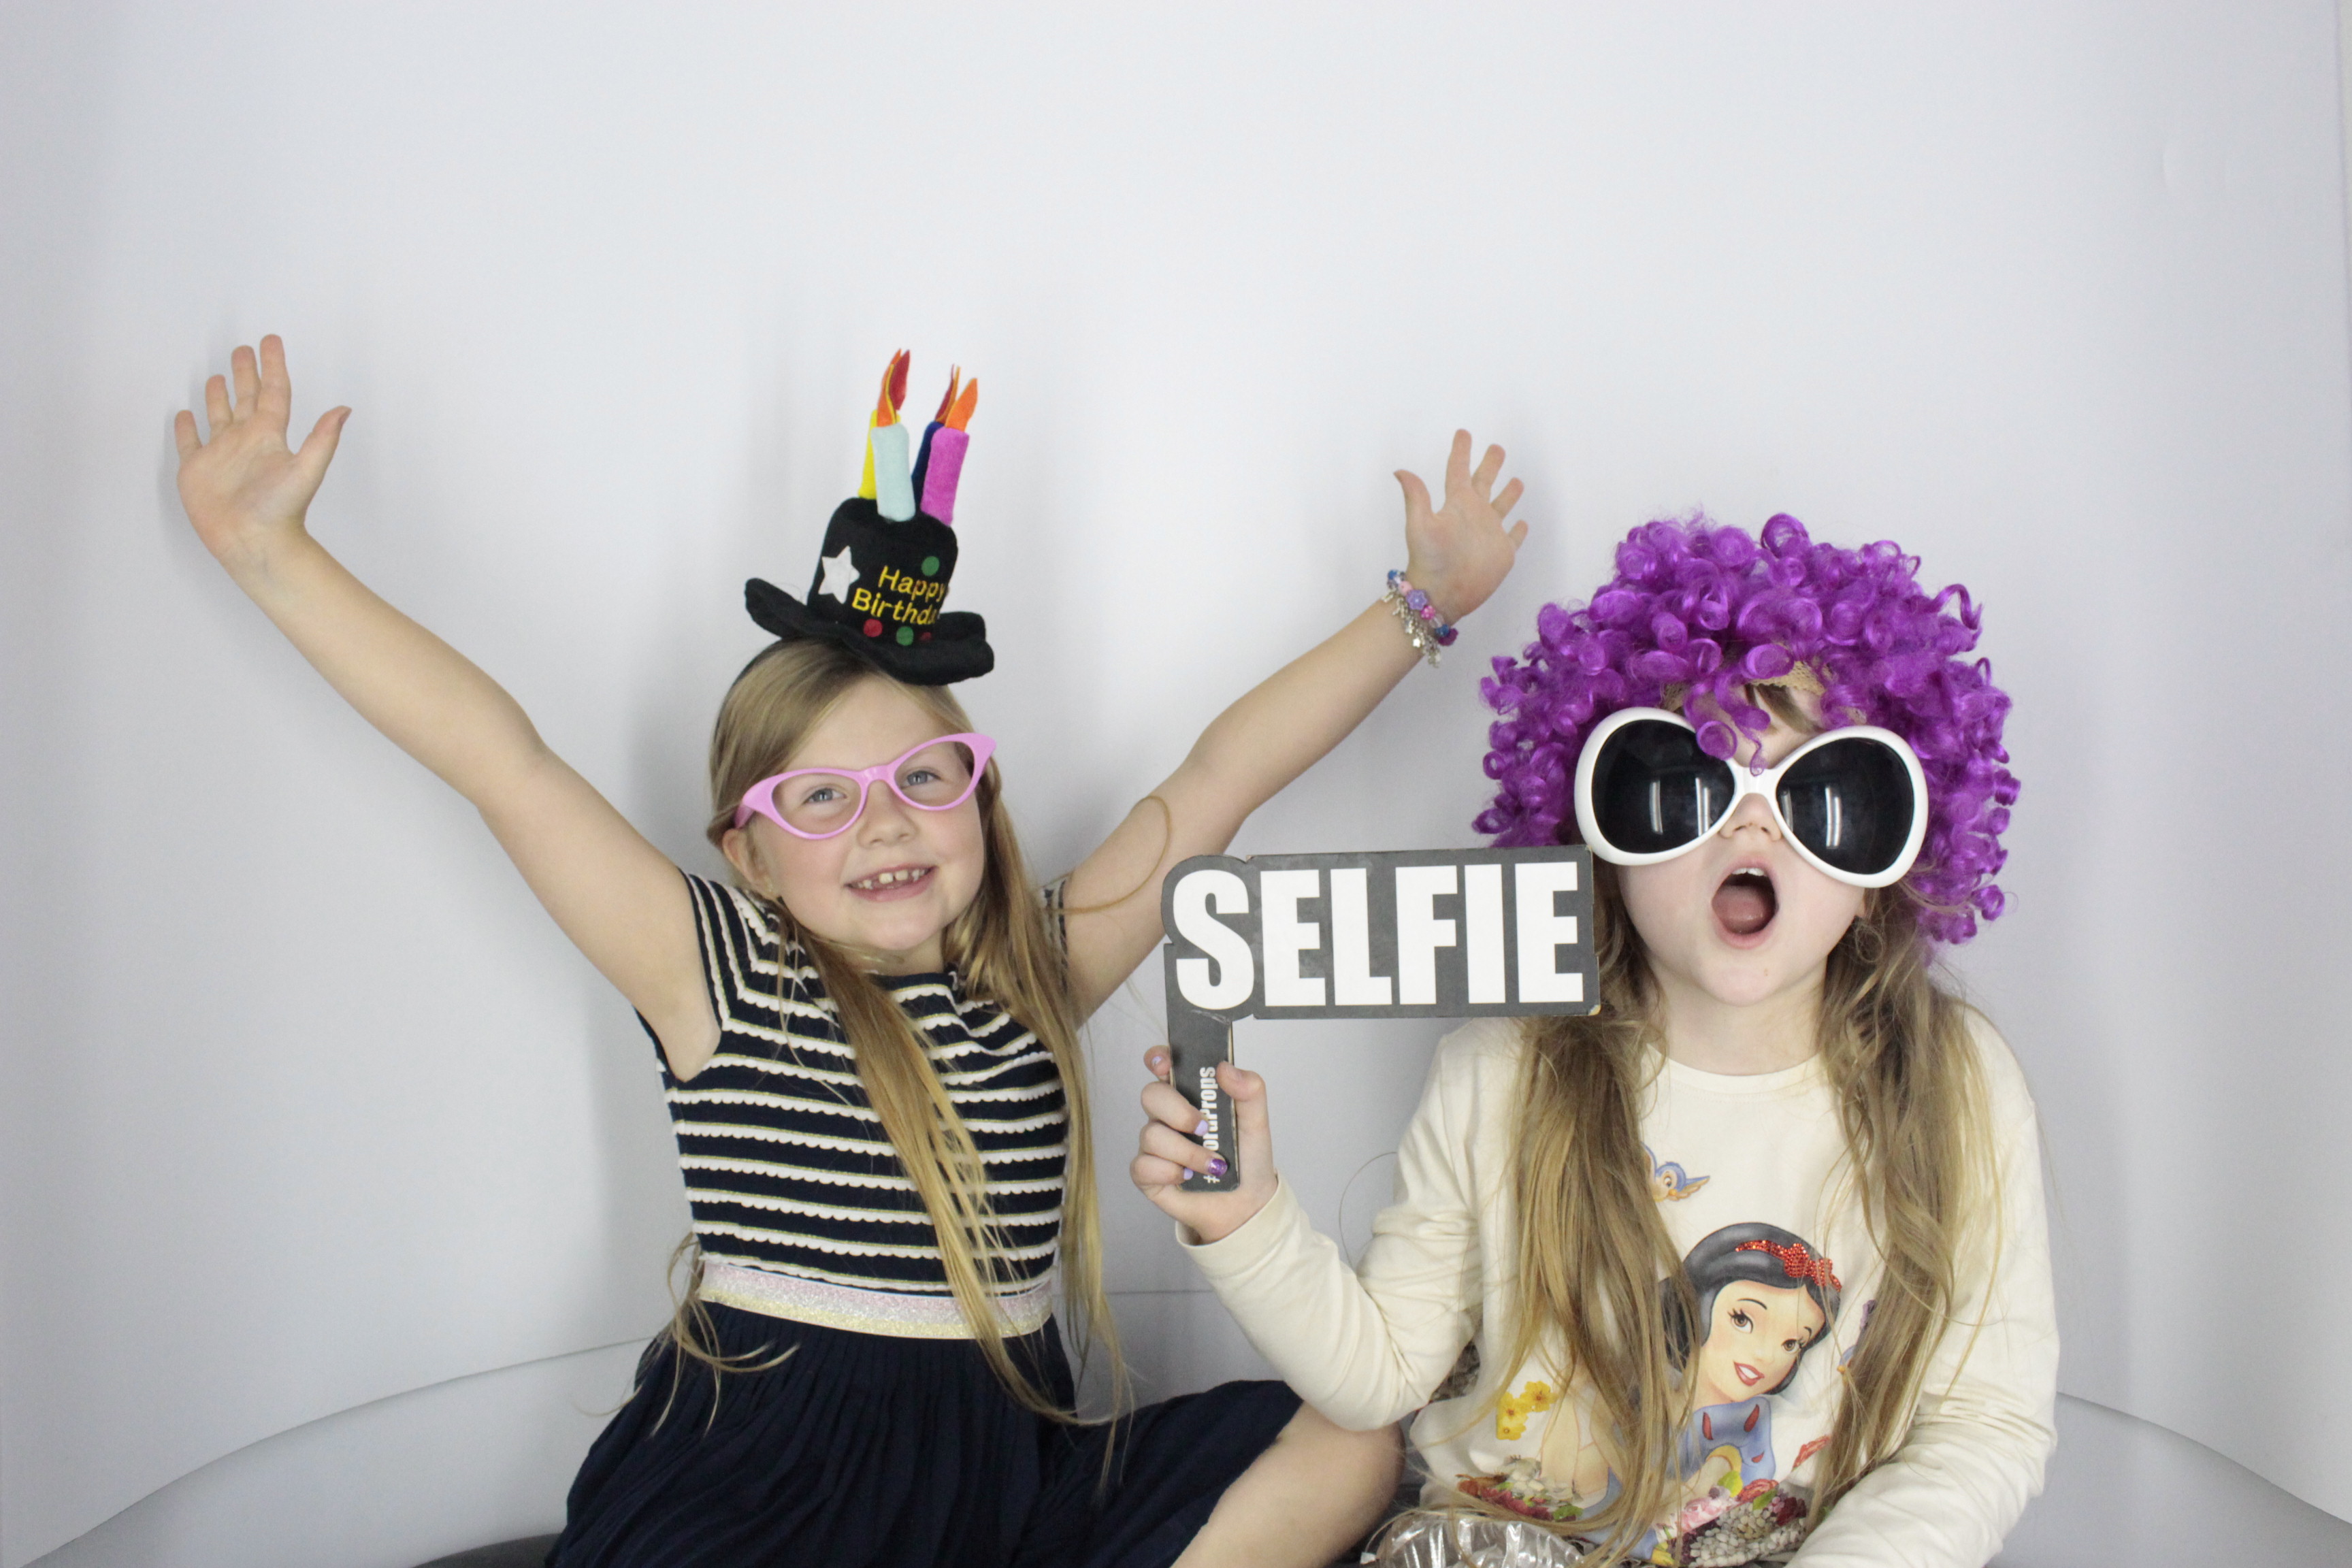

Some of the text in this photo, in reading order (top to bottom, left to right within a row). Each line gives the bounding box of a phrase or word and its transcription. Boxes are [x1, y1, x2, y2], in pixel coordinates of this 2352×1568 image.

[878, 565, 946, 602] Happy
[851, 587, 939, 625] Birthda
[1173, 860, 1584, 1009] SELFIE
